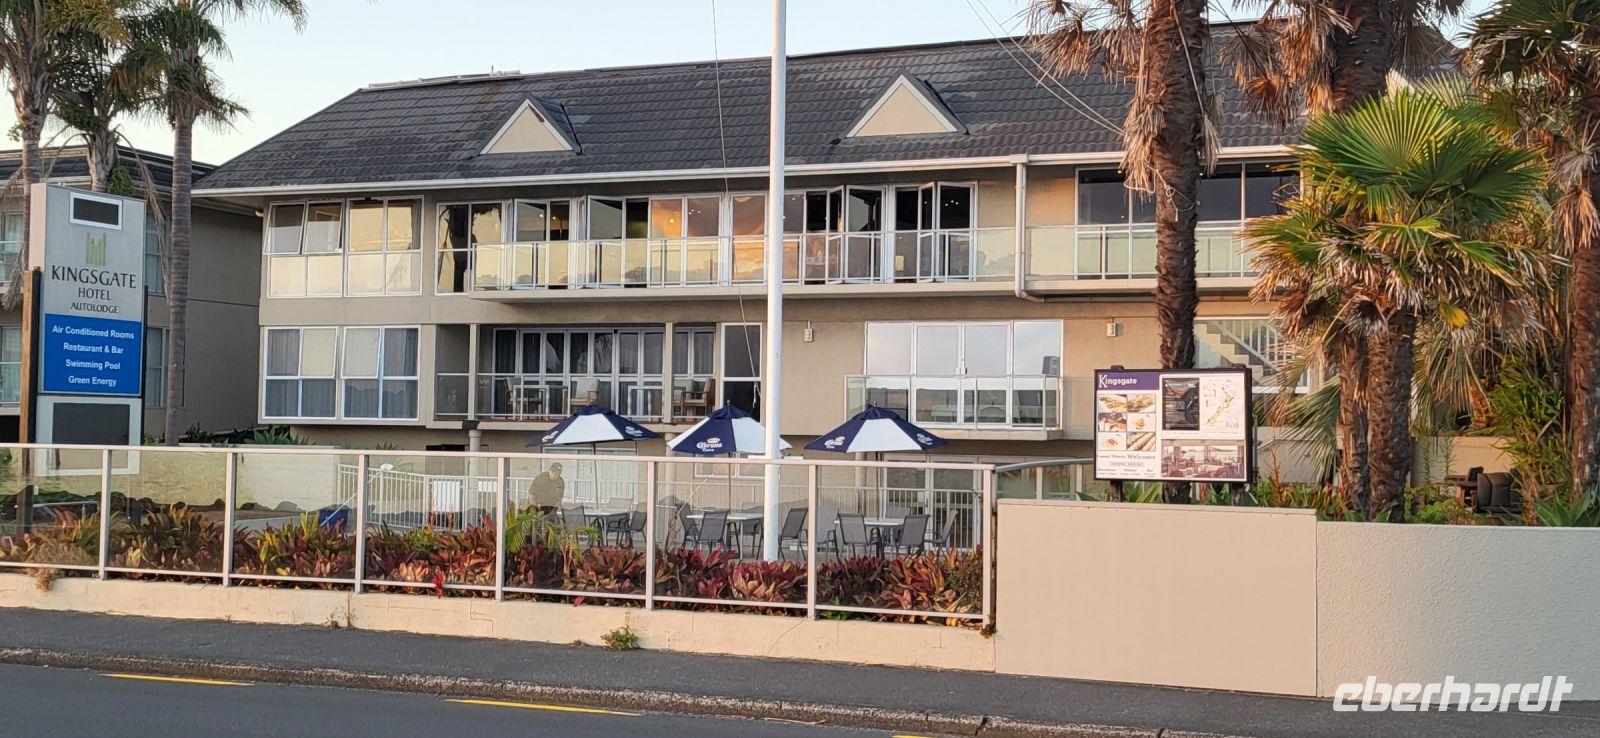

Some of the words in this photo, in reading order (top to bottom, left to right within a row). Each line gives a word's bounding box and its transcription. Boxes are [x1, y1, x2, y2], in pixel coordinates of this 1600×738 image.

[51, 265, 137, 289] KINGSGATE
[78, 287, 112, 301] HOTEL
[70, 302, 119, 314] AUTOLODGE
[52, 325, 64, 334] Air
[65, 326, 109, 337] Conditioned
[110, 330, 135, 339] Rooms
[63, 342, 103, 353] Restaurant
[104, 345, 110, 353] &
[111, 346, 124, 354] Bar
[65, 359, 103, 371] Swimming
[104, 361, 121, 370] Pool
[68, 376, 91, 385] Green
[91, 377, 117, 387] Energy
[1098, 374, 1138, 388] Kingsgate
